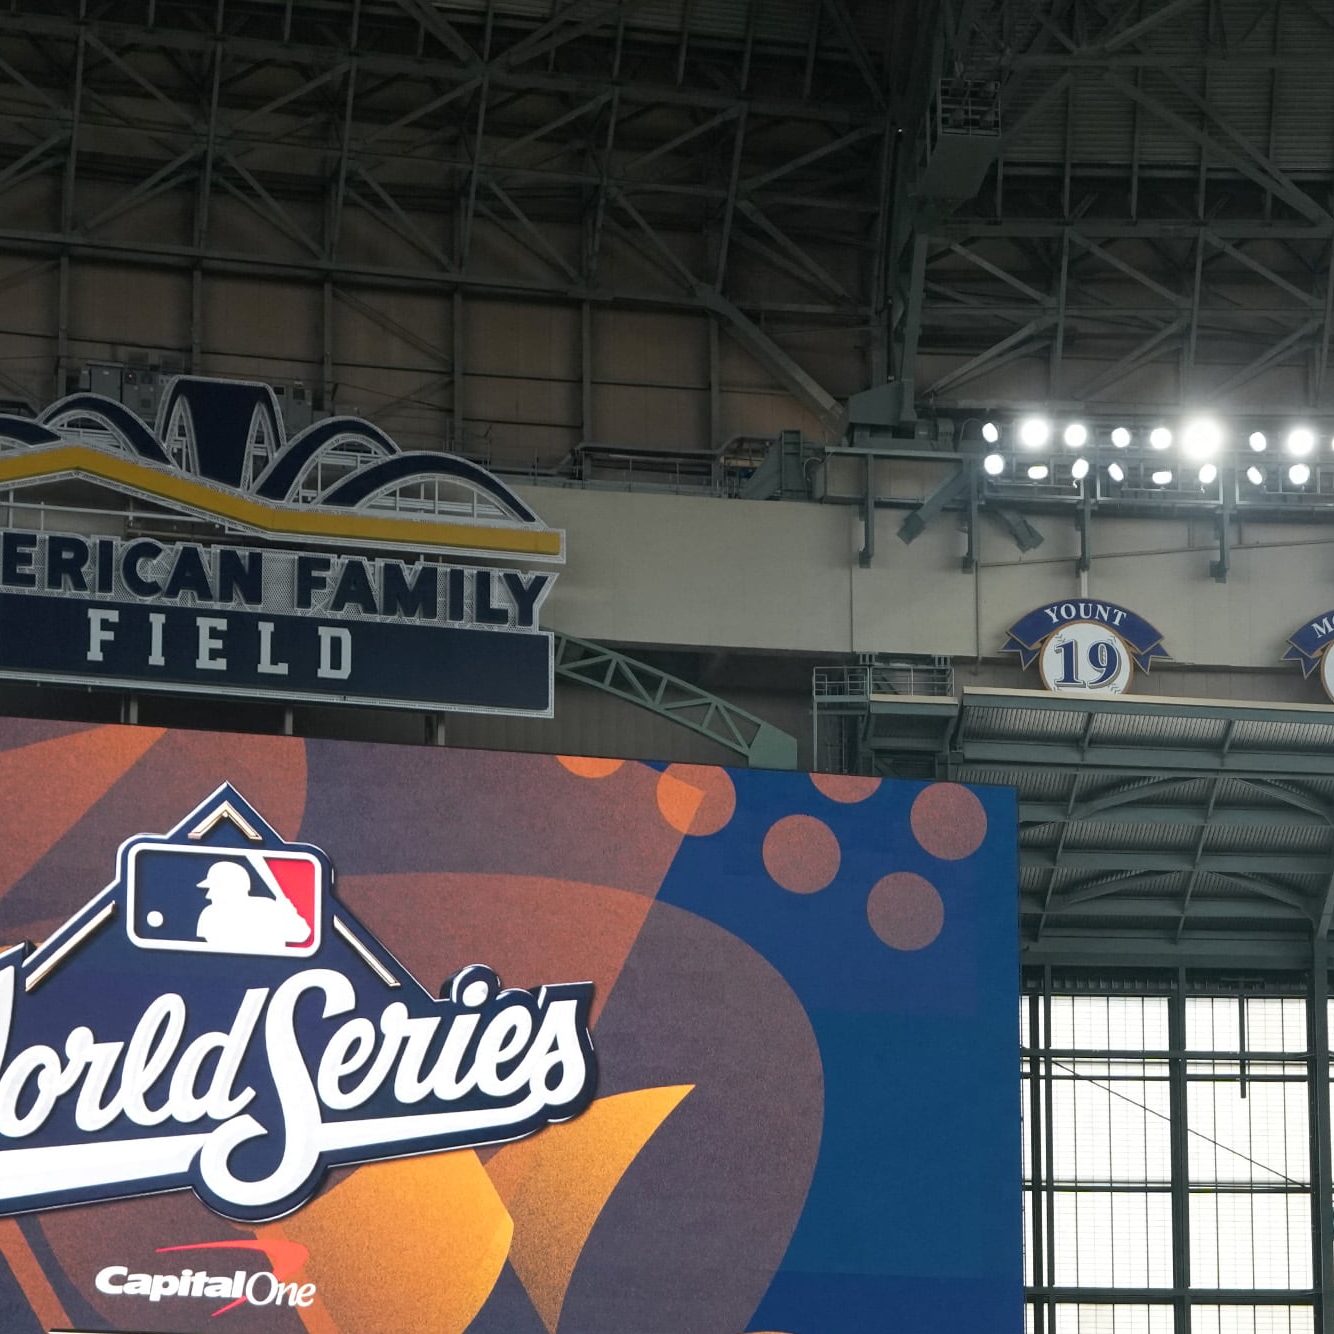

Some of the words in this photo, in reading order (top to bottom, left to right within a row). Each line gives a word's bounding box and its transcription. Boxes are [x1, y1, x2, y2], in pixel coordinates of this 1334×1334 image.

[295, 556, 550, 628] FAMILY
[1044, 603, 1127, 627] YOUNT
[86, 607, 353, 680] FIELD
[1054, 640, 1121, 689] 19
